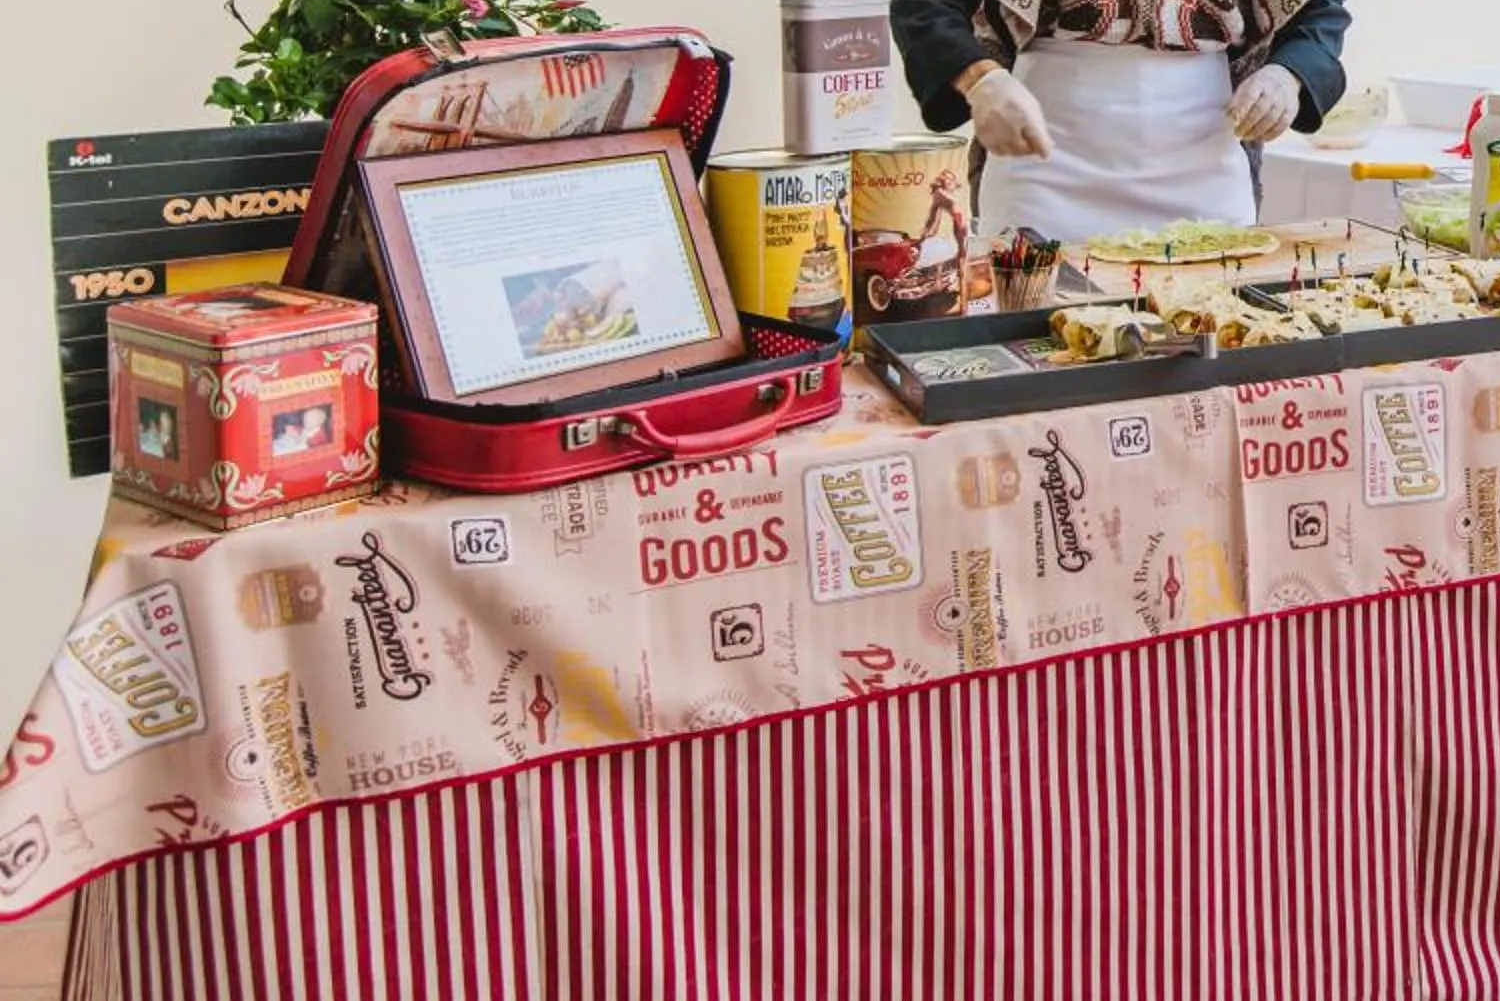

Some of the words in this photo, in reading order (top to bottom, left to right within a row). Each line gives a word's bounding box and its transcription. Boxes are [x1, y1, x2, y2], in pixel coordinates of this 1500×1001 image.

[823, 70, 885, 94] COFFEE
[901, 171, 925, 186] 50
[163, 189, 312, 225] CANZON
[70, 267, 155, 300] 1950
[1190, 396, 1206, 432] RADE
[1280, 400, 1304, 430] &
[1242, 427, 1350, 480] GOODS
[1375, 392, 1441, 497] COFFEE
[566, 485, 587, 535] TRADE
[694, 488, 726, 524] &
[889, 460, 910, 515] 1891
[1028, 429, 1093, 574] Guaranteed
[639, 516, 789, 586] GOODS
[820, 468, 914, 588] COFFEE
[149, 590, 183, 651] 1891
[334, 531, 431, 701] Guaranteed
[1028, 615, 1105, 650] HOUSE
[66, 619, 199, 738] COFFEE
[345, 617, 367, 709] SATISFACTION
[347, 750, 386, 770] NEW
[350, 751, 457, 792] HOUSE
